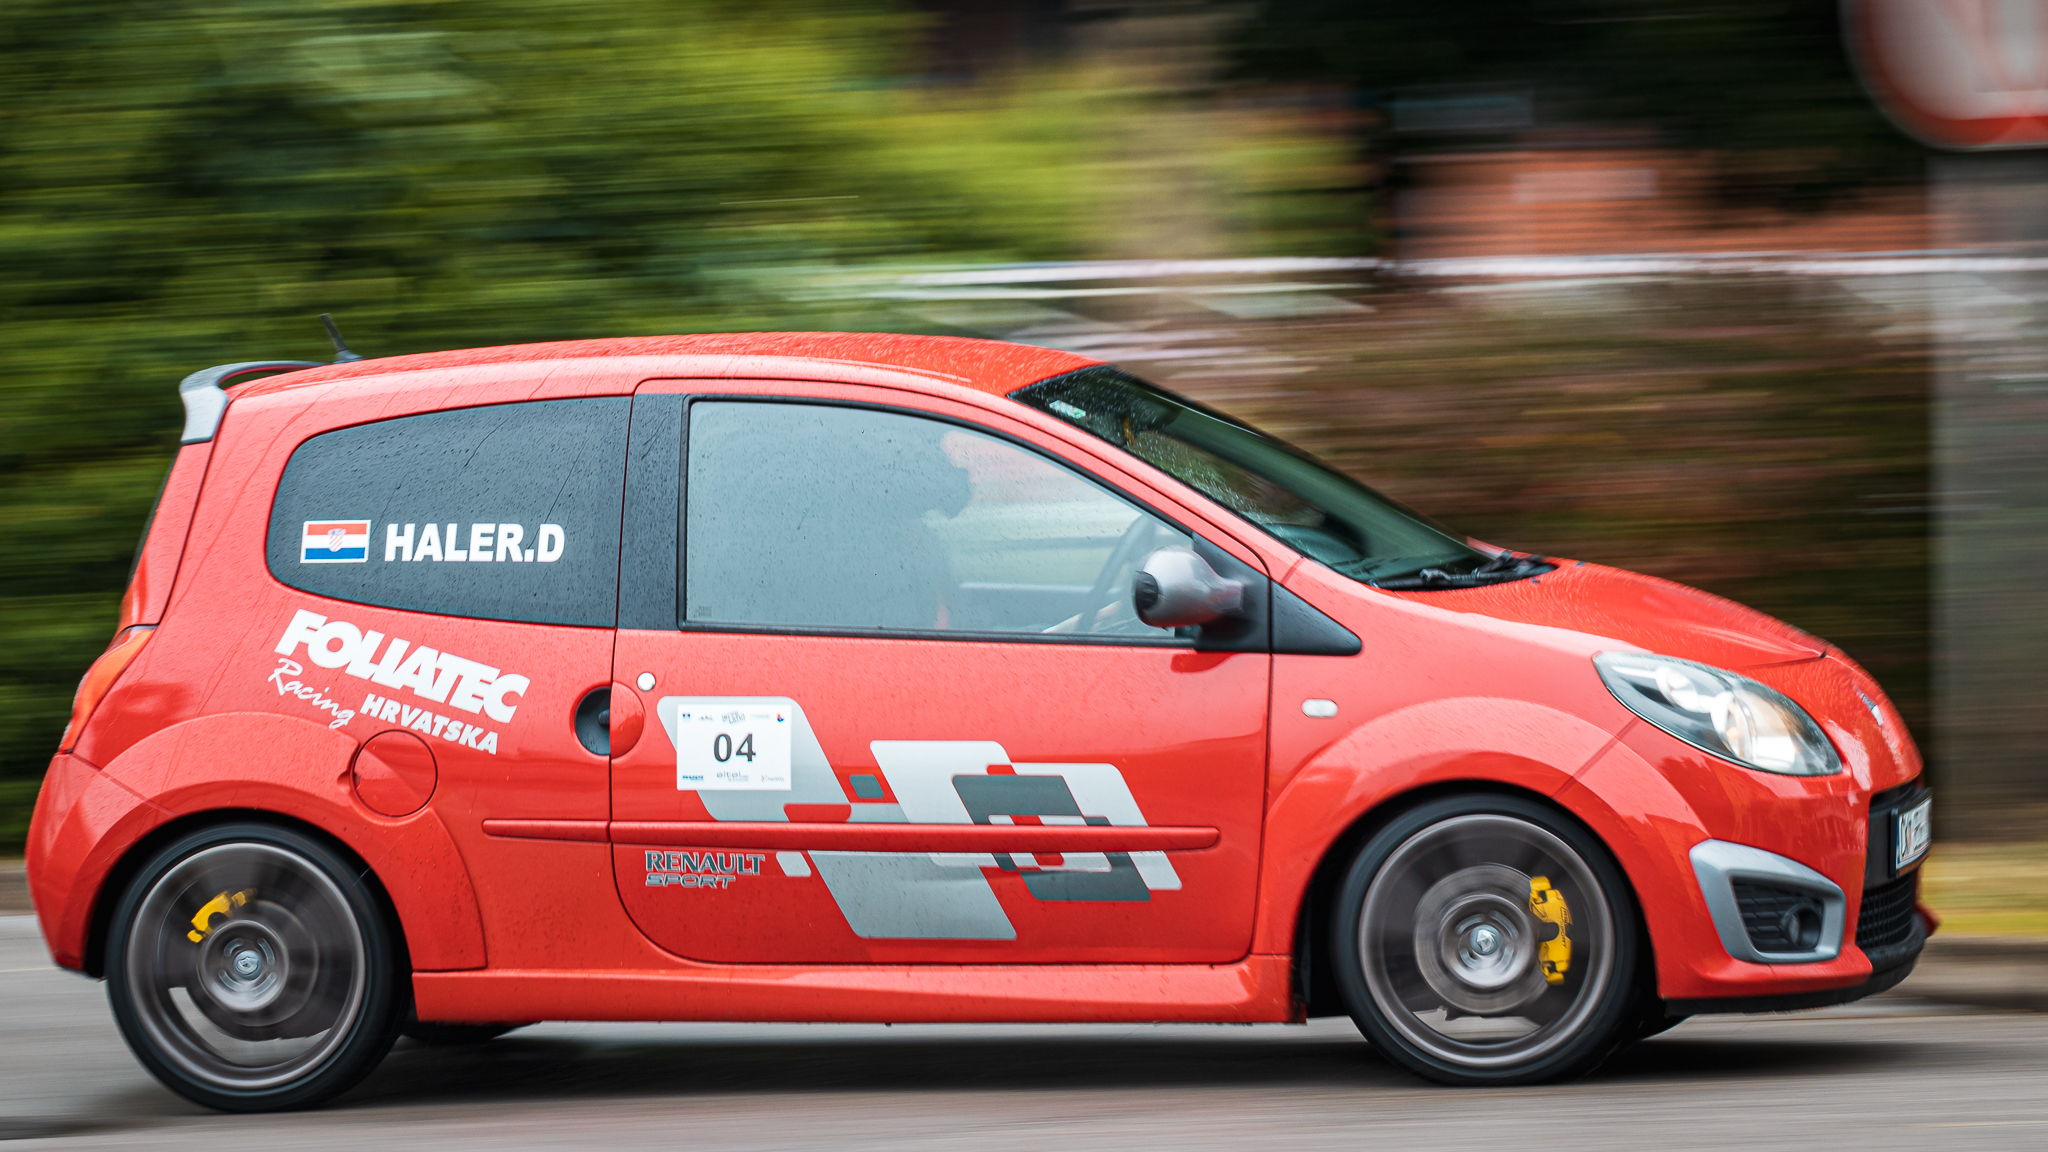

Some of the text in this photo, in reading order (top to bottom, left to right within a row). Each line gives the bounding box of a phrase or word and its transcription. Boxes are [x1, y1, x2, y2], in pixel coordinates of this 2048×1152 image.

[384, 523, 565, 562] HALER.D
[274, 608, 530, 724] FOLIATEC
[267, 657, 355, 730] Racing
[360, 693, 498, 755] HRVATSKA
[713, 732, 756, 763] 04
[645, 850, 765, 875] RENAULT
[645, 873, 736, 889] SPORT
